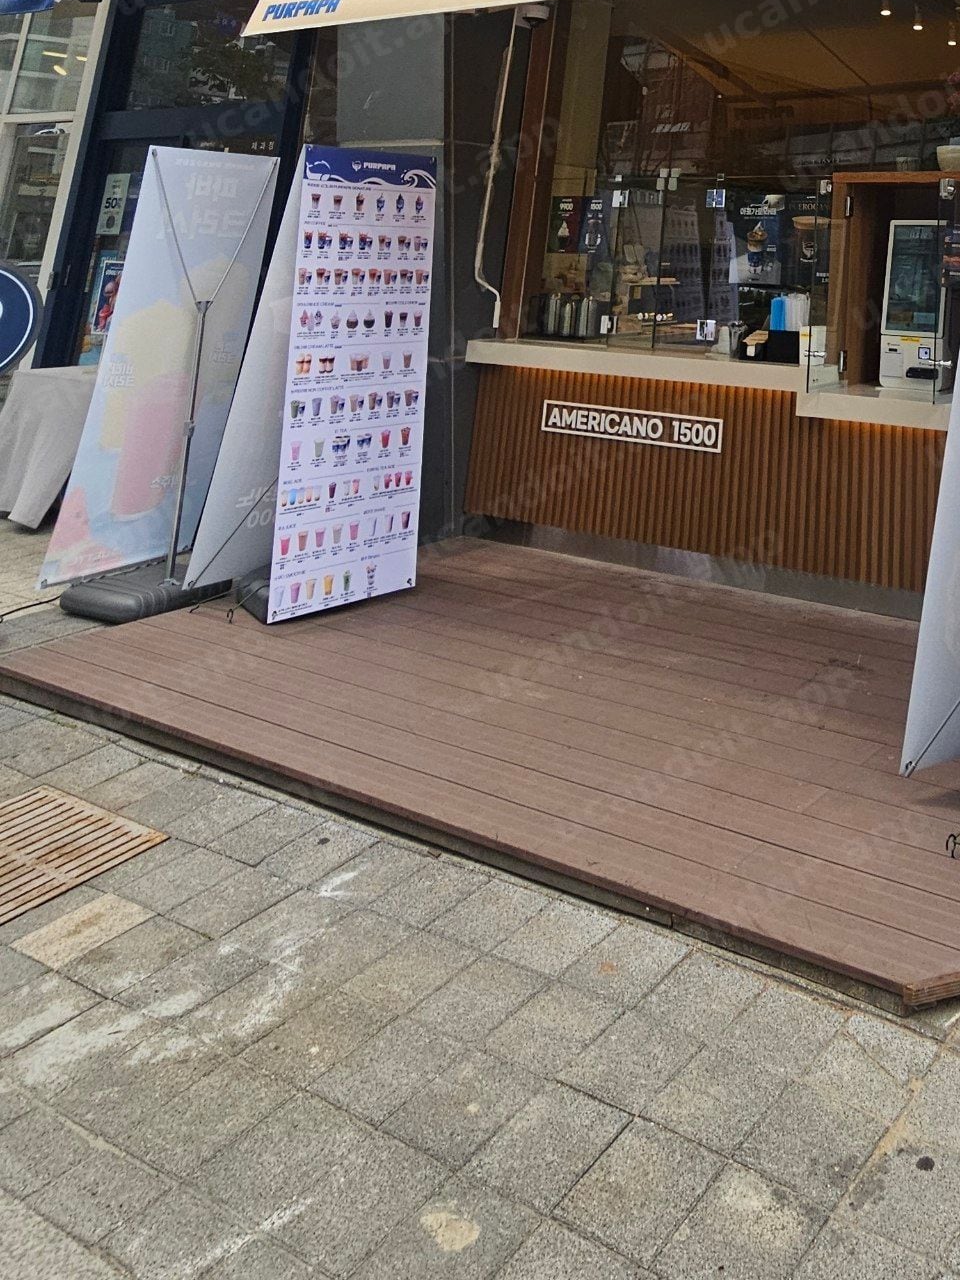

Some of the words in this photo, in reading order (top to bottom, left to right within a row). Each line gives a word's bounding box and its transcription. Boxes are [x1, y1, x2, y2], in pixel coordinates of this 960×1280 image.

[363, 161, 397, 171] PURPAPA
[547, 406, 664, 440] AMERICANO
[672, 420, 716, 447] 1500
